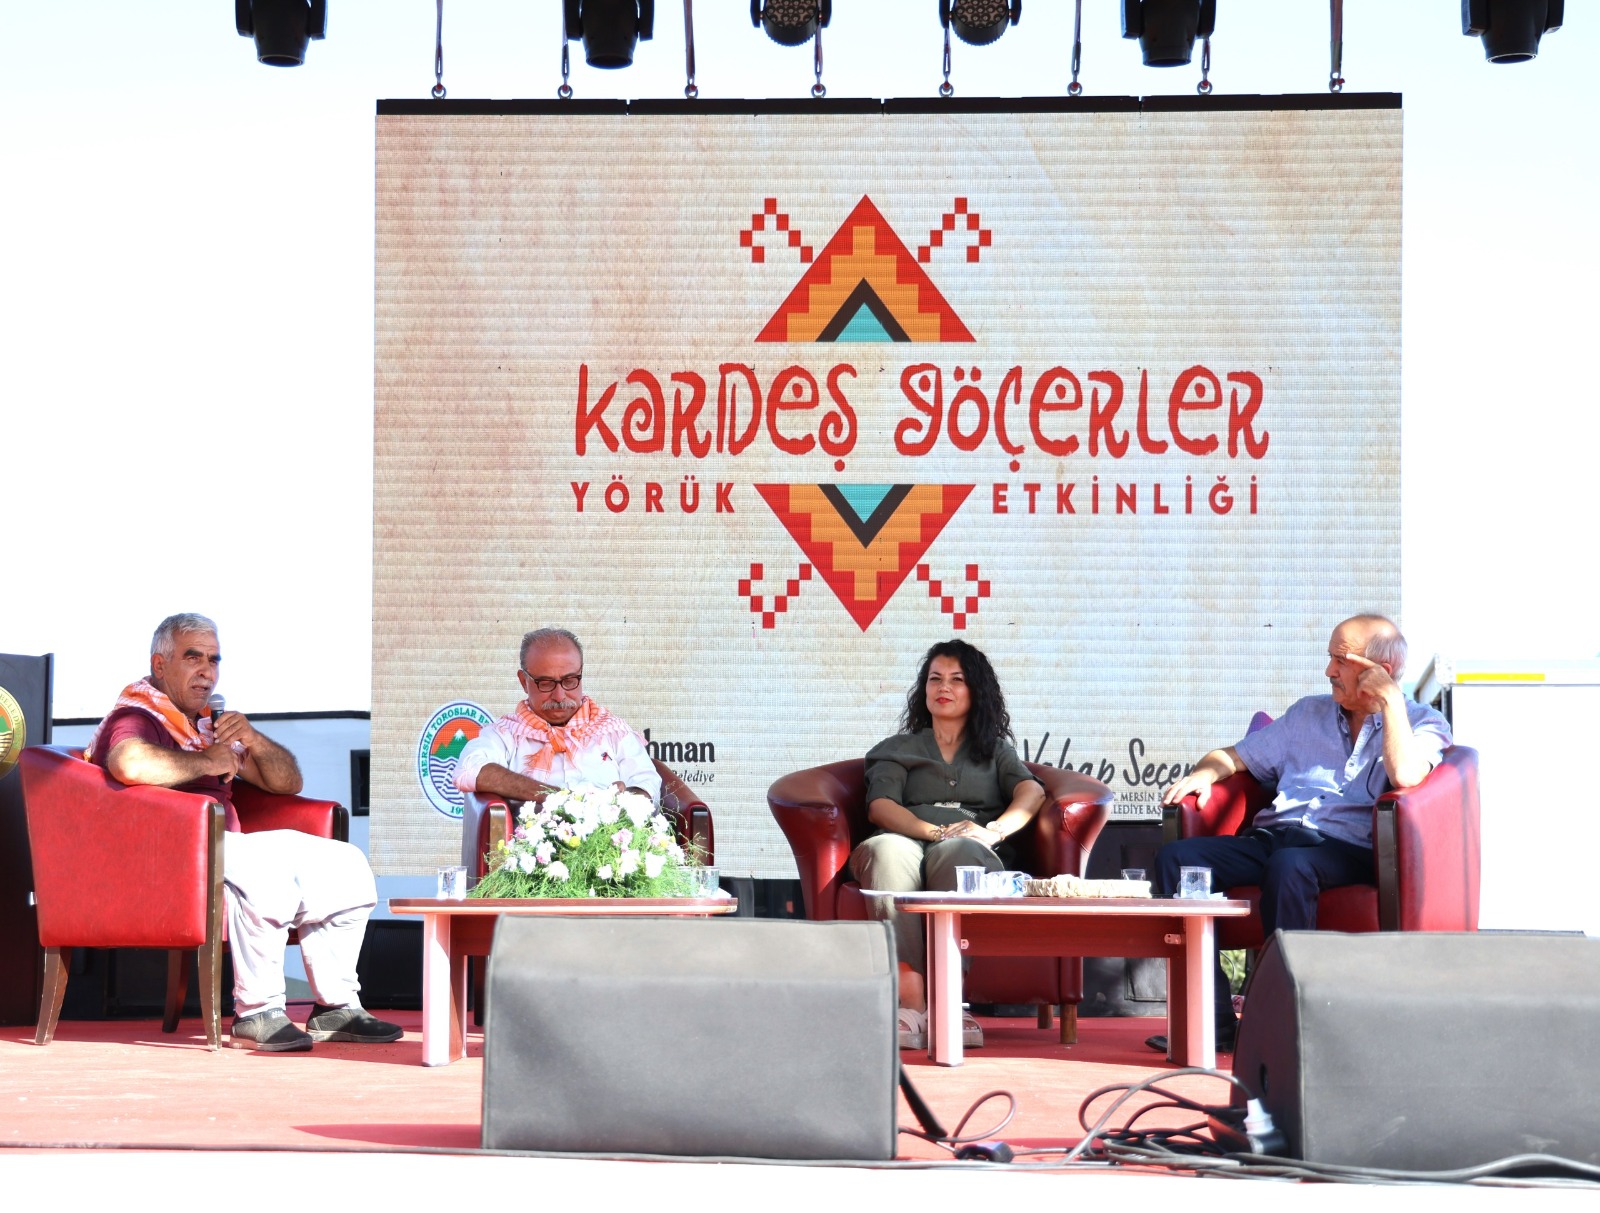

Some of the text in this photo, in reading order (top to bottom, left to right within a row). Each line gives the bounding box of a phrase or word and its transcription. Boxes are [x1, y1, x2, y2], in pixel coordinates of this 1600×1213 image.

[571, 474, 1258, 515] YÖRÜK ETKİNLİĞİ
[431, 707, 477, 731] TOROSLAR
[643, 728, 715, 762] hman
[1120, 792, 1155, 802] MERSİN
[1111, 804, 1162, 817] LEDİYE BAŞ
